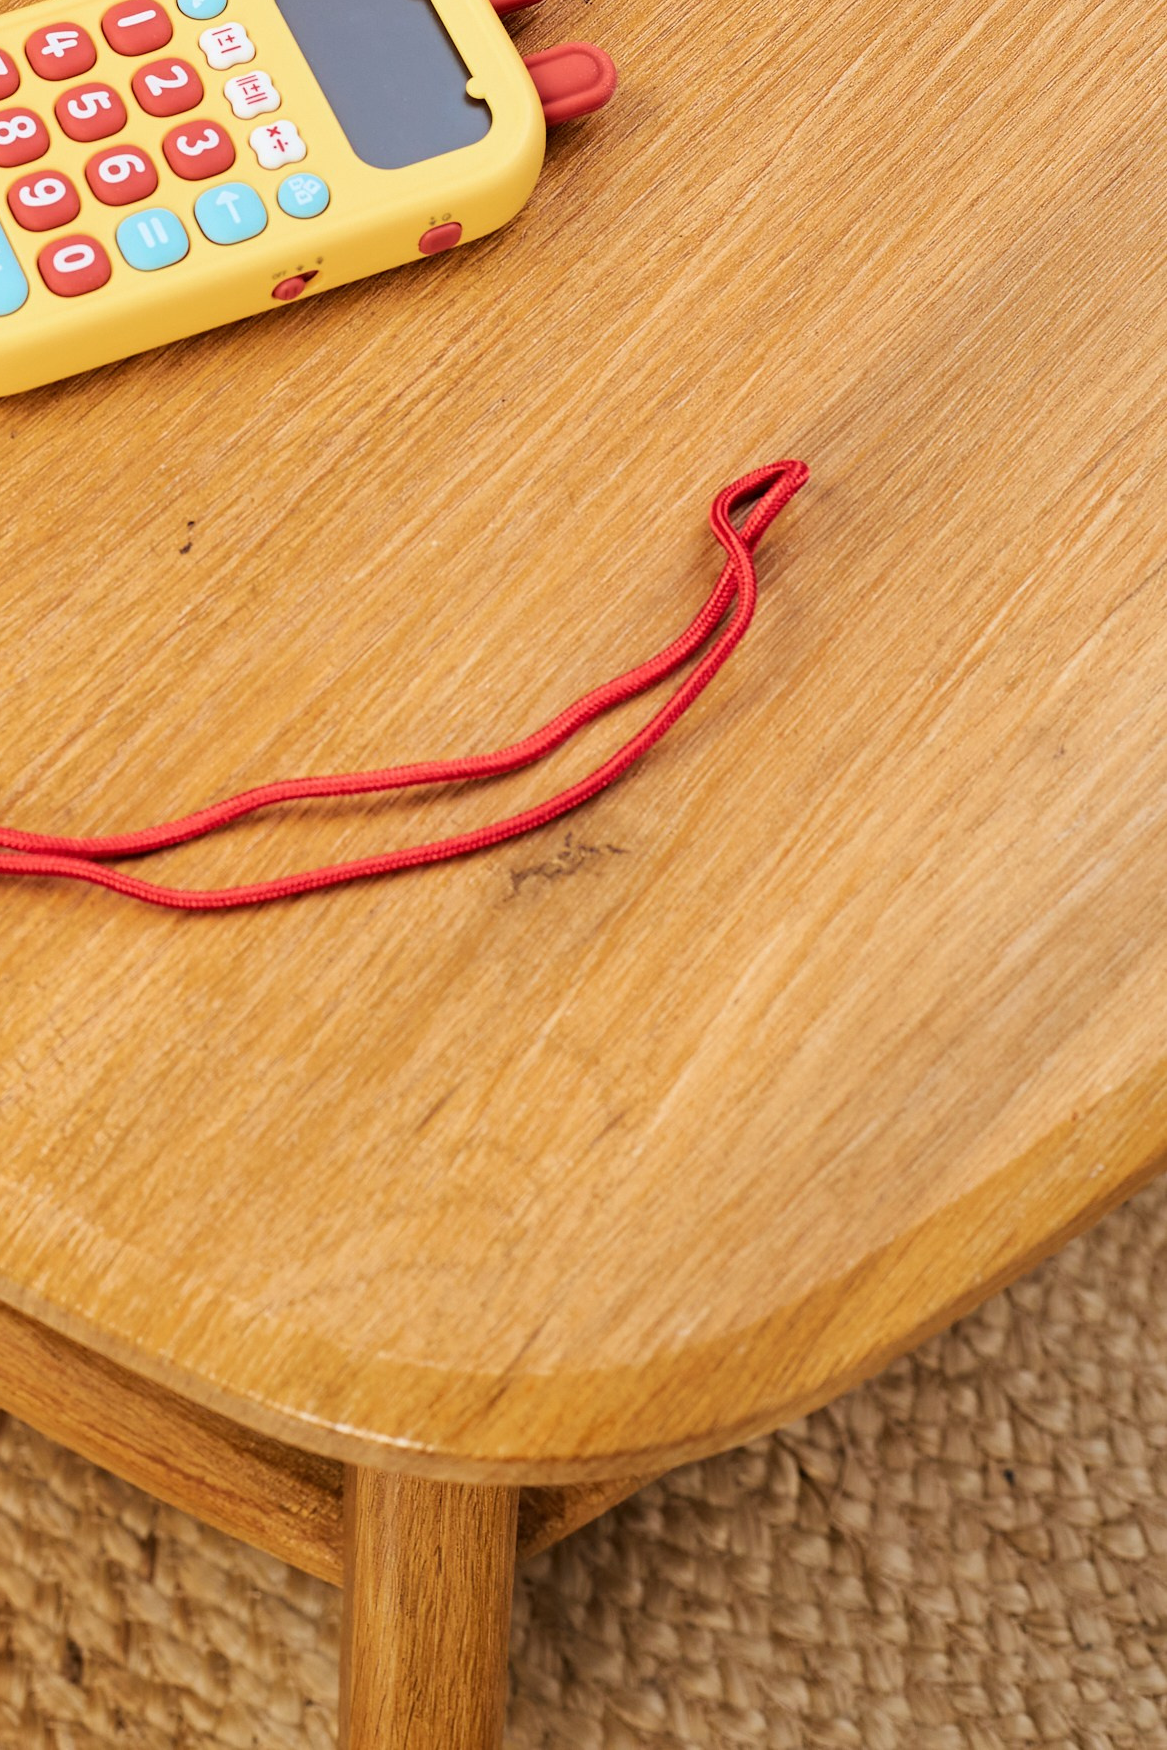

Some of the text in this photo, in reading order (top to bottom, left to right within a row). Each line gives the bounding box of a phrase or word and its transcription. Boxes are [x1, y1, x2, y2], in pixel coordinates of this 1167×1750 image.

[117, 9, 157, 28] 1
[41, 31, 79, 58] 4
[144, 65, 188, 96] 2
[67, 91, 112, 119] 5
[176, 128, 220, 156] 3
[98, 154, 146, 183] 6
[18, 177, 66, 207] 9
[52, 244, 95, 273] 0
